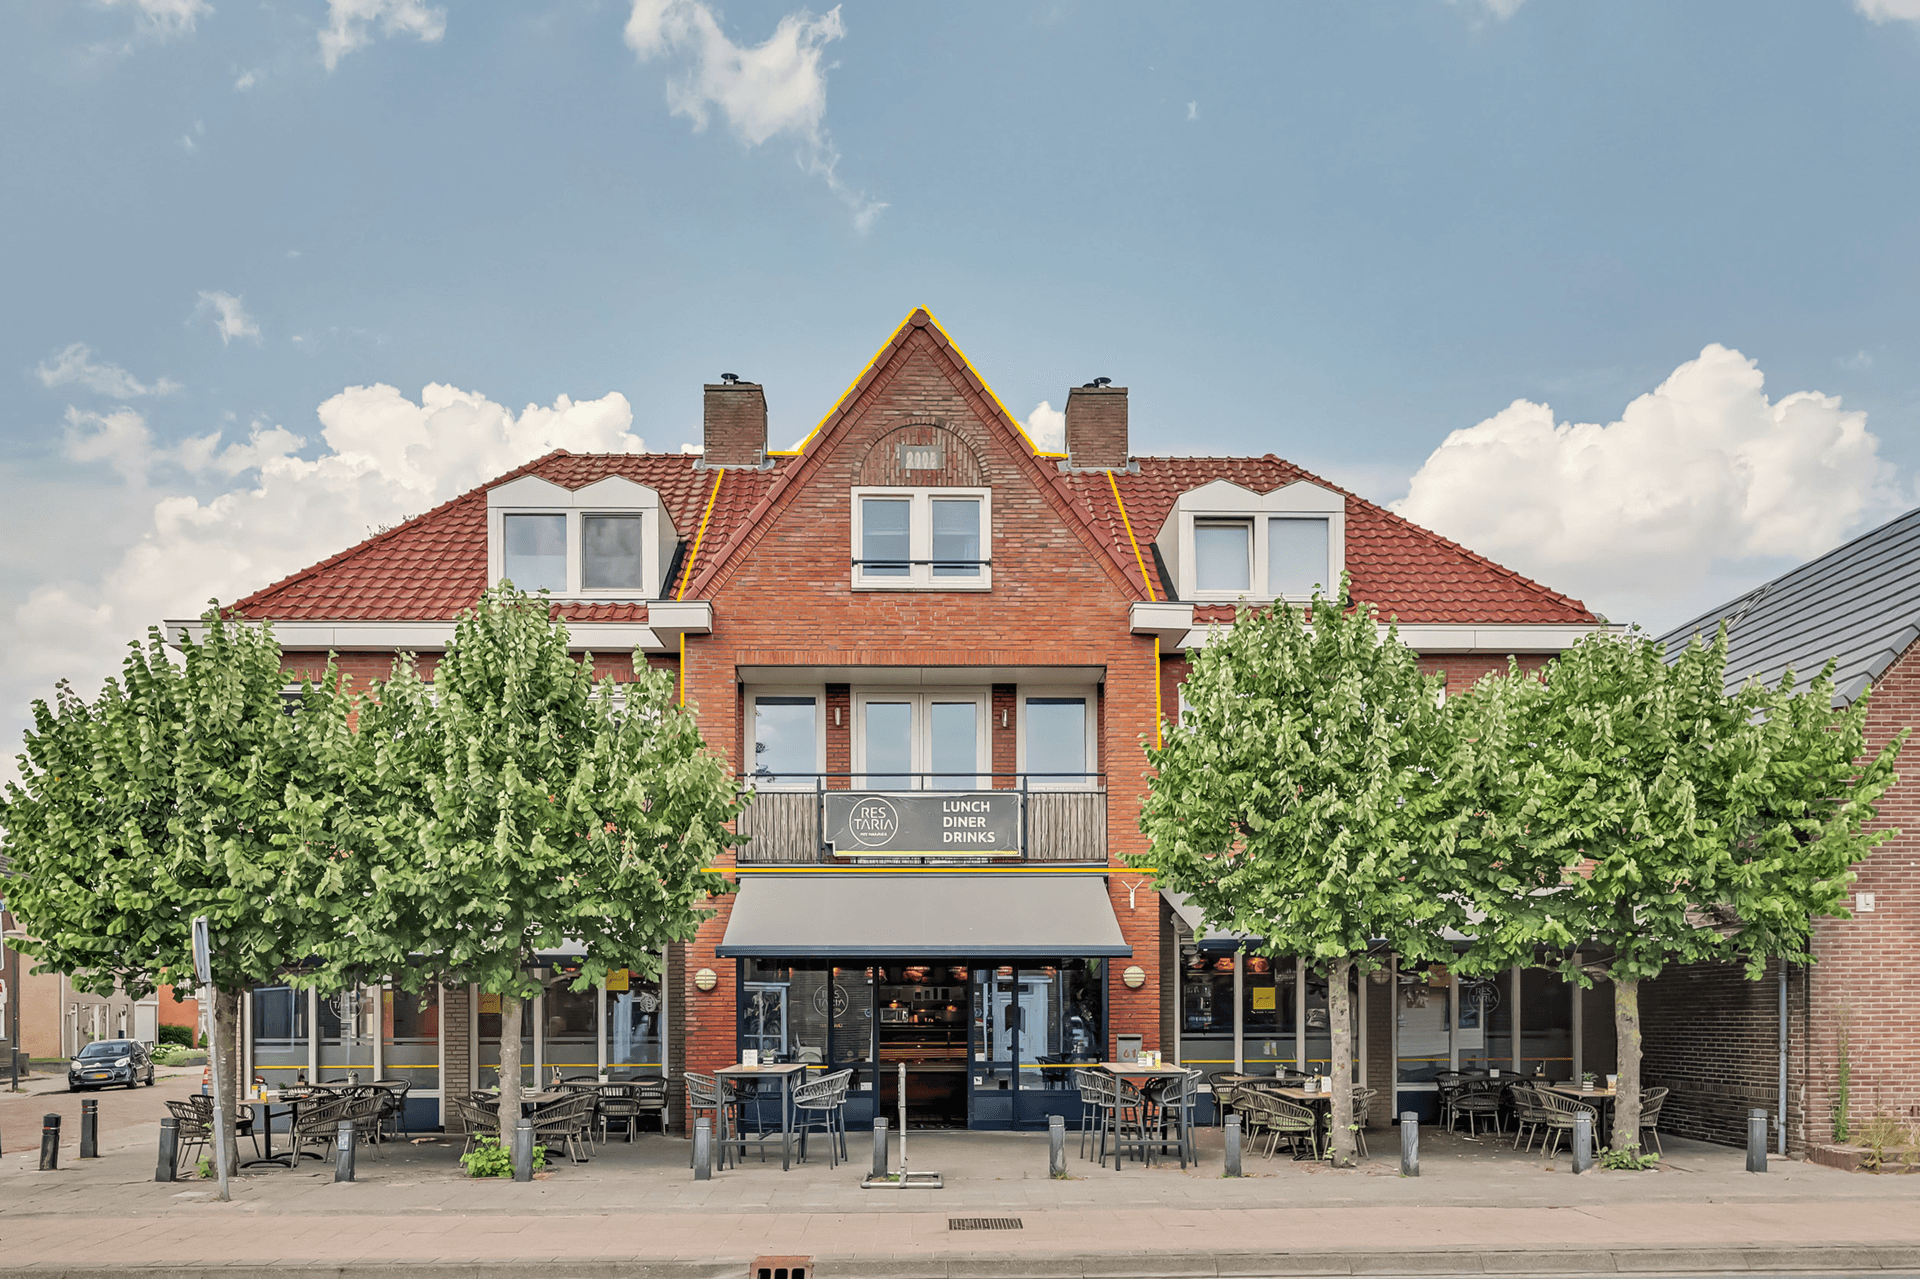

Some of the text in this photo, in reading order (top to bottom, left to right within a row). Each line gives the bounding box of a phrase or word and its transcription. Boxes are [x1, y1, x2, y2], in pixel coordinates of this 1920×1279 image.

[943, 801, 990, 812] LUNCH
[861, 807, 886, 818] RES
[854, 819, 893, 830] TARIA
[943, 816, 986, 827] DINER
[943, 832, 995, 842] DRINKS
[1123, 1049, 1136, 1058] 61
